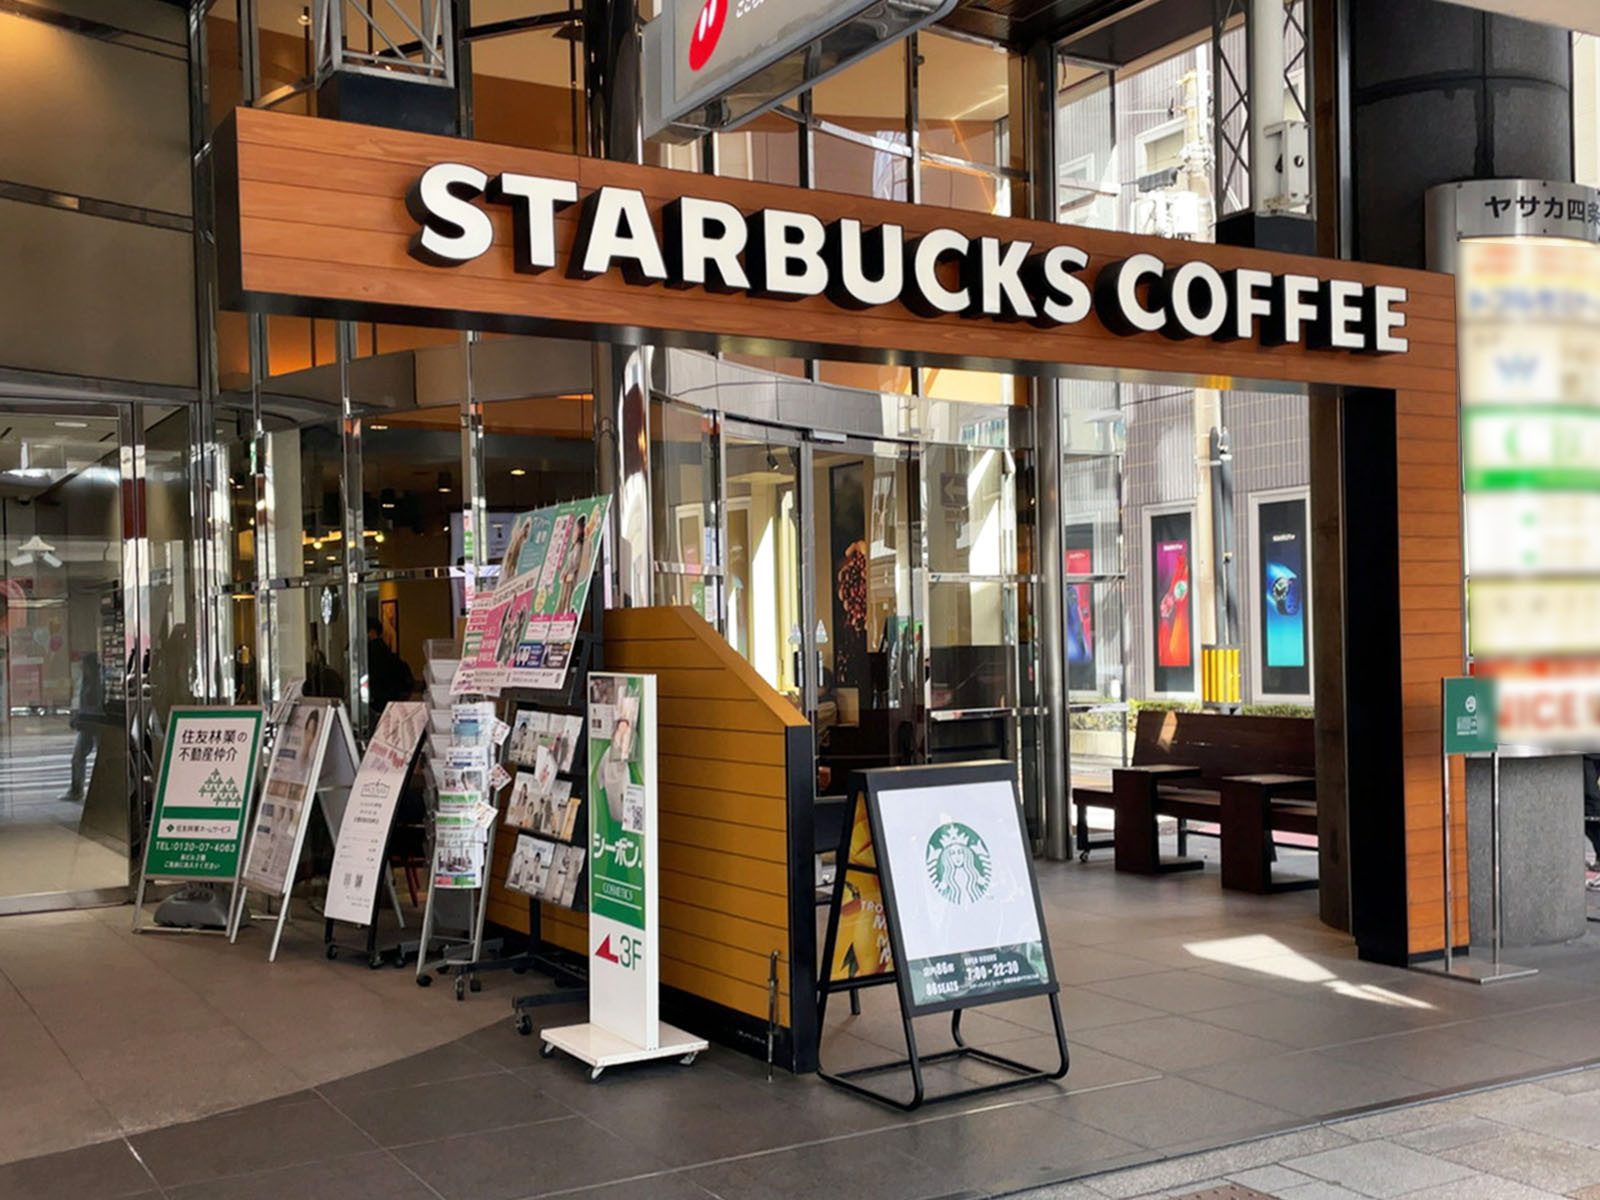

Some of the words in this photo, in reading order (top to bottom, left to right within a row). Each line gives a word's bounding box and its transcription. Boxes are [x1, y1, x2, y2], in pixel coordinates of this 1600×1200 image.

[417, 162, 1092, 324] STARBUCKS
[1117, 252, 1410, 353] COFFEE
[181, 729, 248, 745] 住友林業の
[178, 746, 238, 762] 不動産仲介
[860, 900, 884, 913] TRO
[619, 934, 642, 971] 3F
